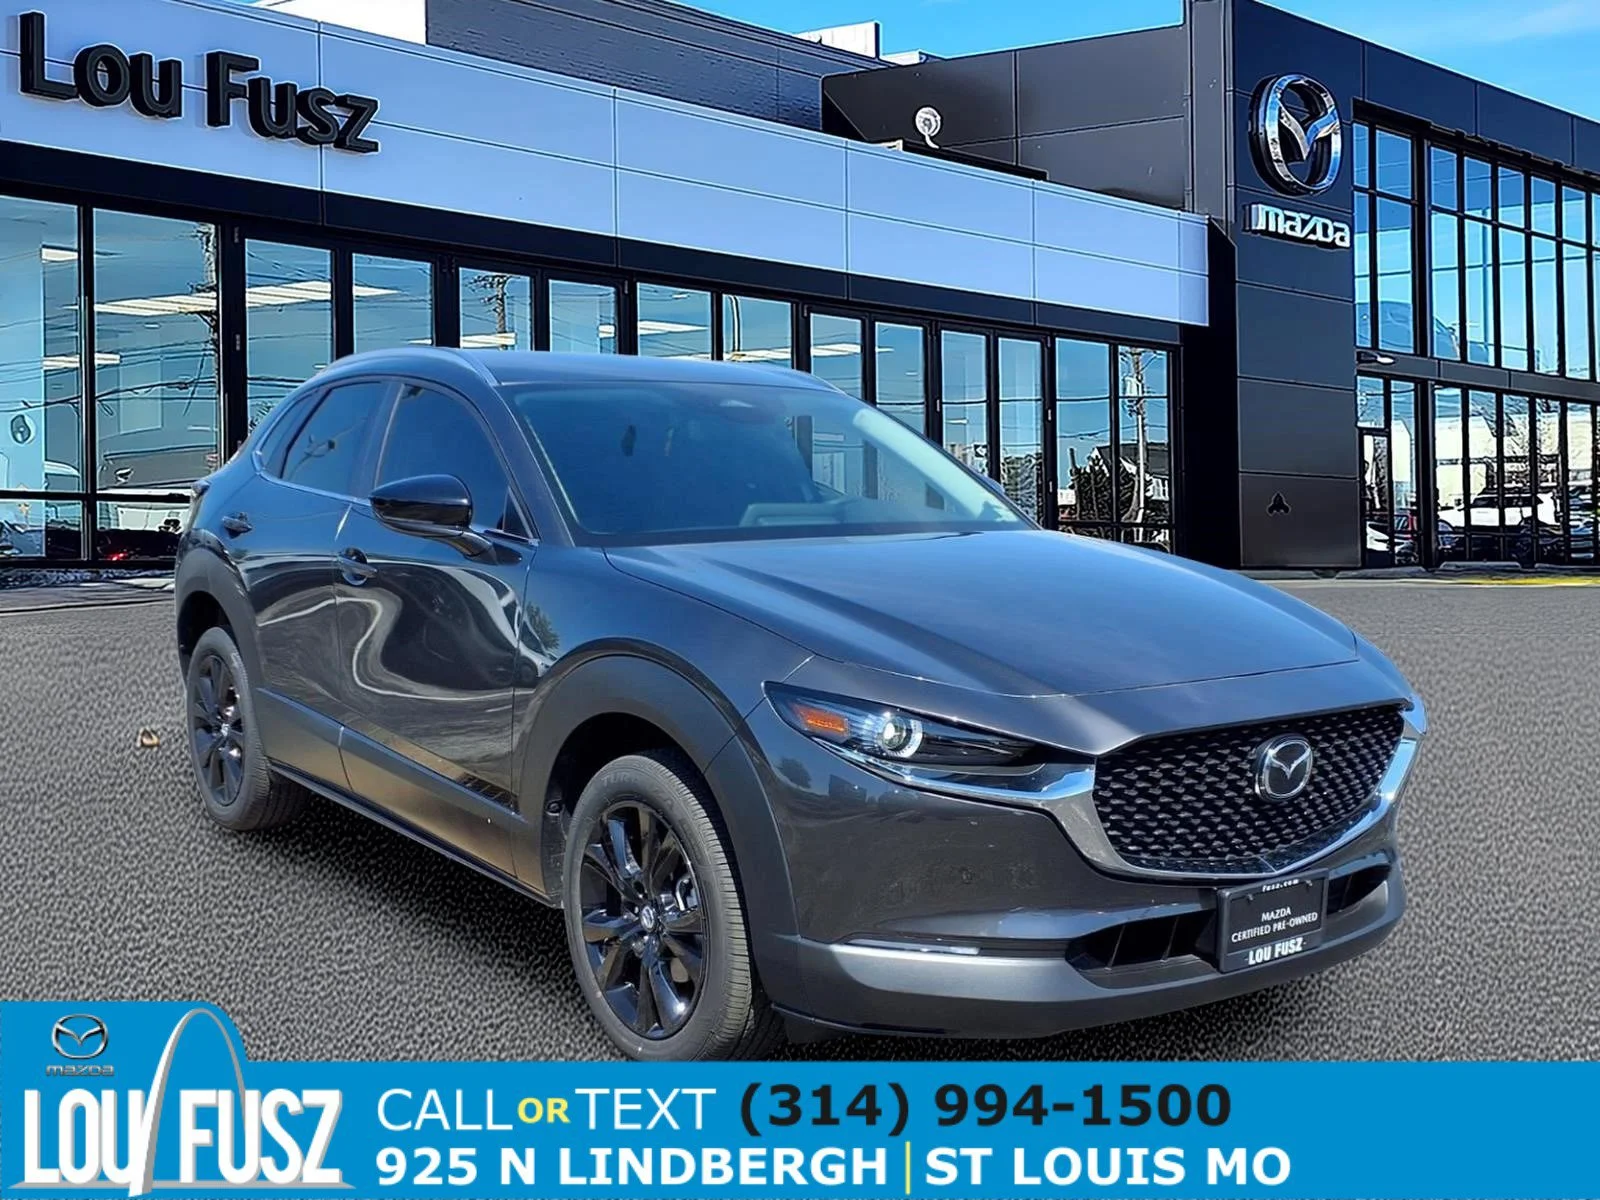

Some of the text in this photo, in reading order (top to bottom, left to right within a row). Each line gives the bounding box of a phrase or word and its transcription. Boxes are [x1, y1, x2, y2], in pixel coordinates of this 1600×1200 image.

[19, 11, 379, 153] Lou Fusz
[1249, 203, 1351, 248] mazda
[1231, 912, 1318, 943] CERTIFIED PRE-OWNED
[1261, 907, 1292, 922] MAZDA
[1248, 937, 1304, 965] LOU FUSZ
